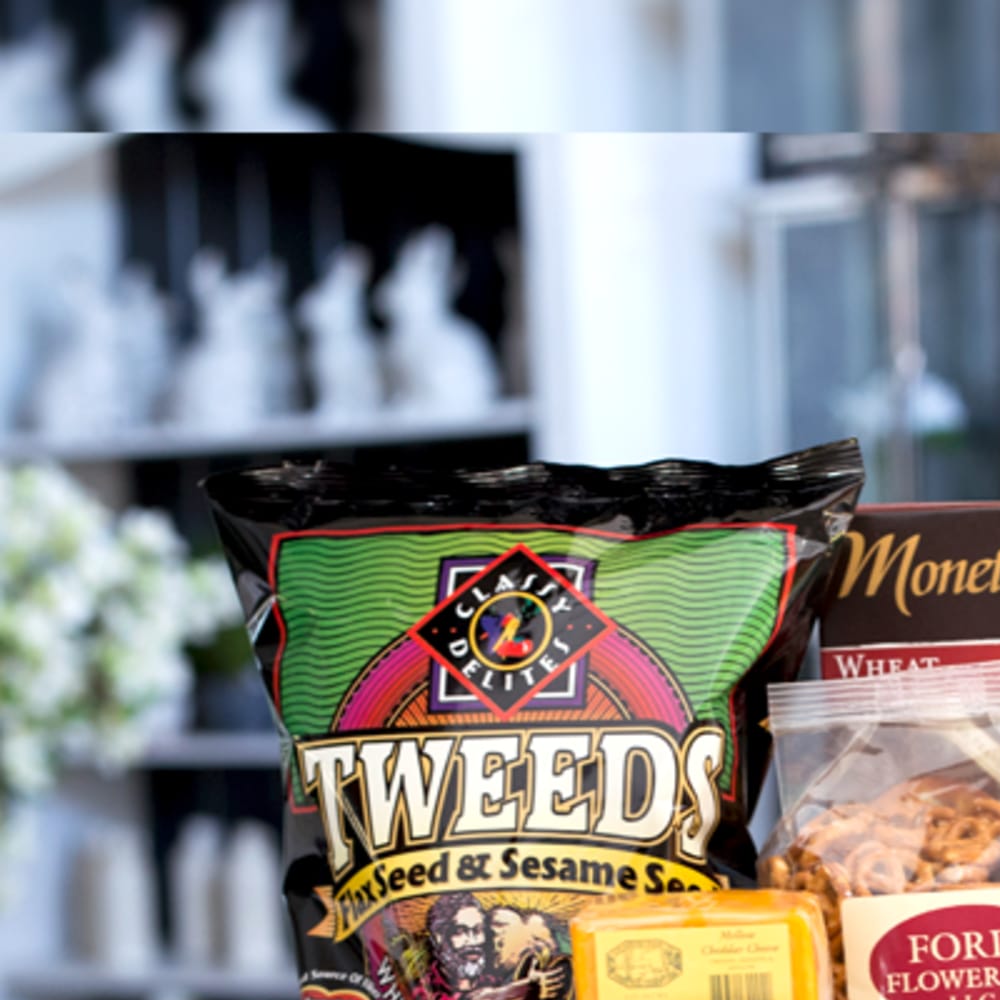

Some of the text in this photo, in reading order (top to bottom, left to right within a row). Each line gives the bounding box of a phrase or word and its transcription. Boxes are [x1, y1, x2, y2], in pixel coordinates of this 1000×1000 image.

[455, 573, 572, 620] CLASSY
[449, 637, 571, 692] DELITES
[299, 726, 725, 880] TWEEDS
[374, 851, 450, 899] Seed
[456, 854, 490, 882] &
[500, 847, 637, 891] Sesame
